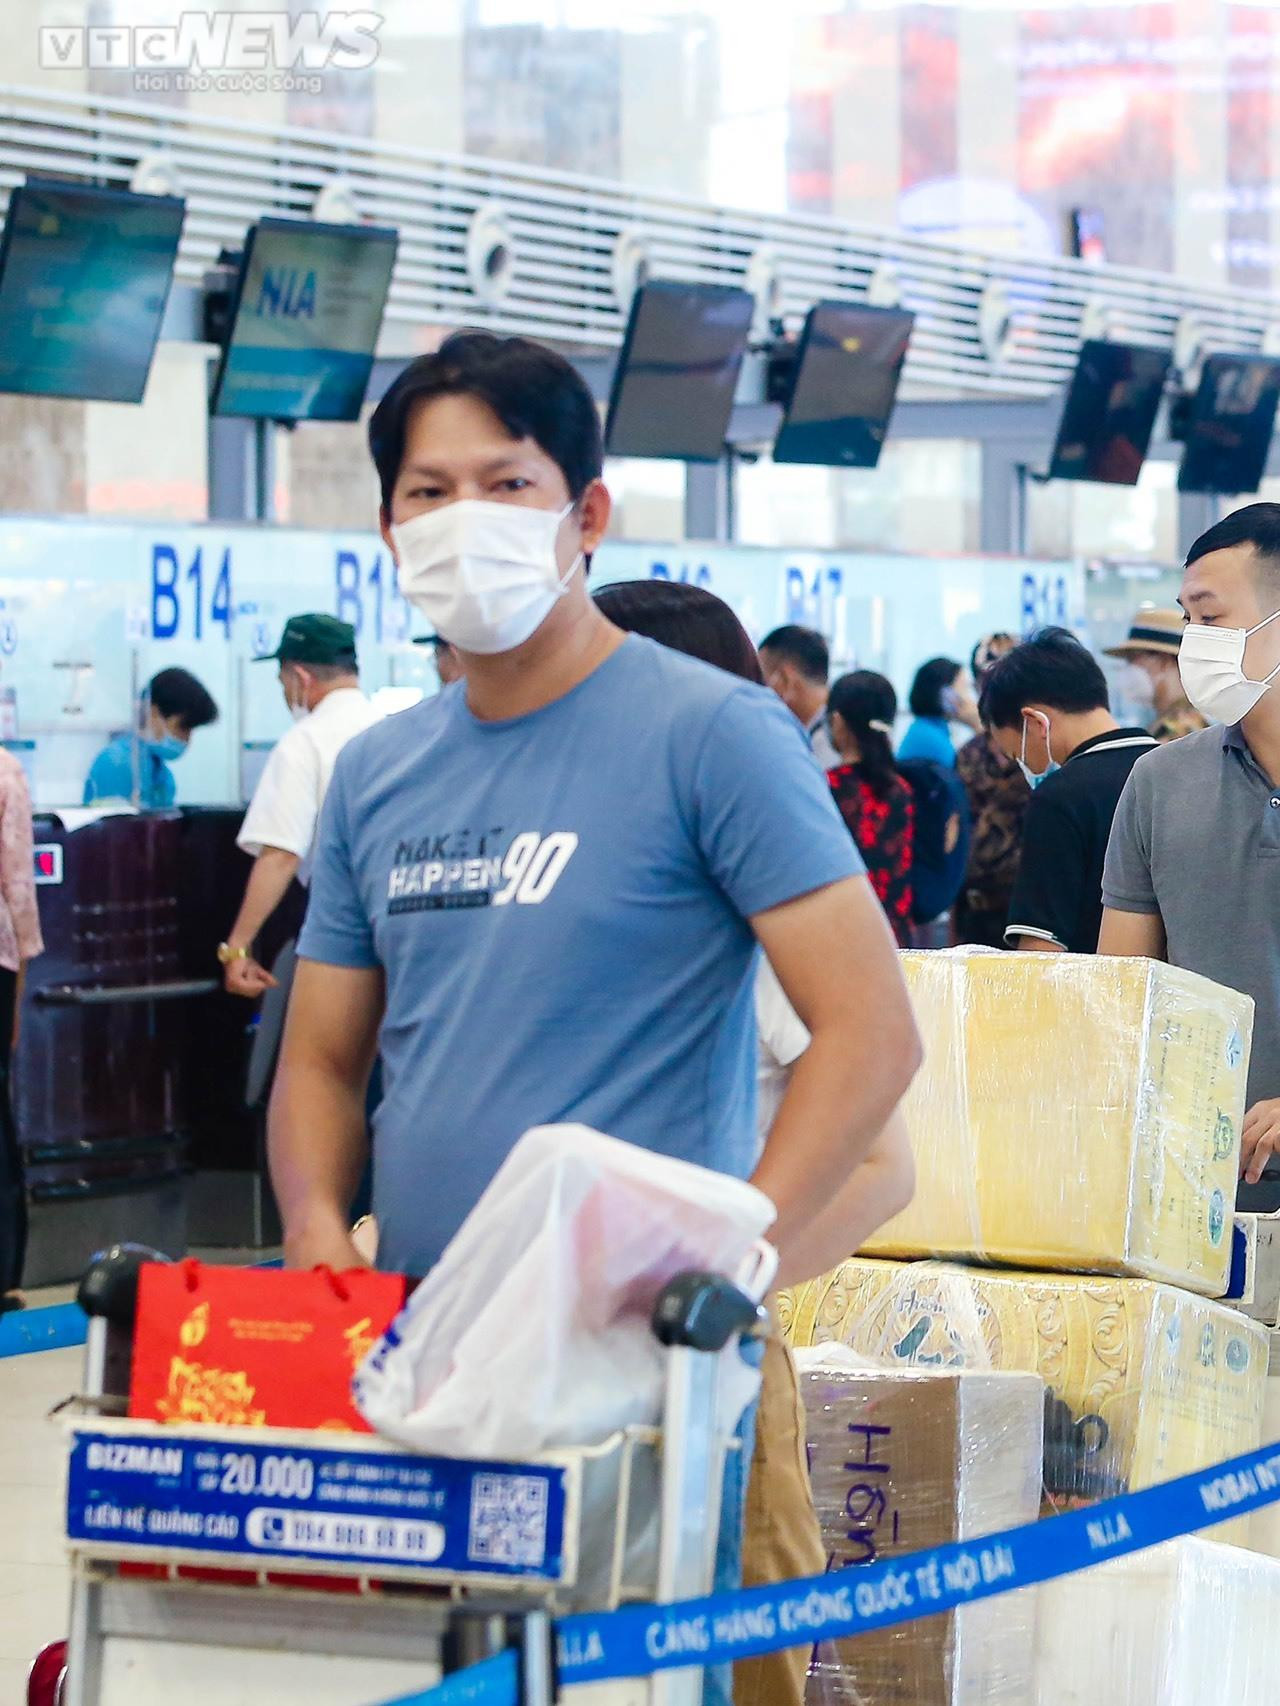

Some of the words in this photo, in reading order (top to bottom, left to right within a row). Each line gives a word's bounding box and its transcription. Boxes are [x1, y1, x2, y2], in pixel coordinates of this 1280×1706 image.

[152, 543, 231, 641] B14
[388, 856, 501, 899] HAPPEN
[492, 831, 579, 906] 90
[220, 1452, 314, 1500] 20.000
